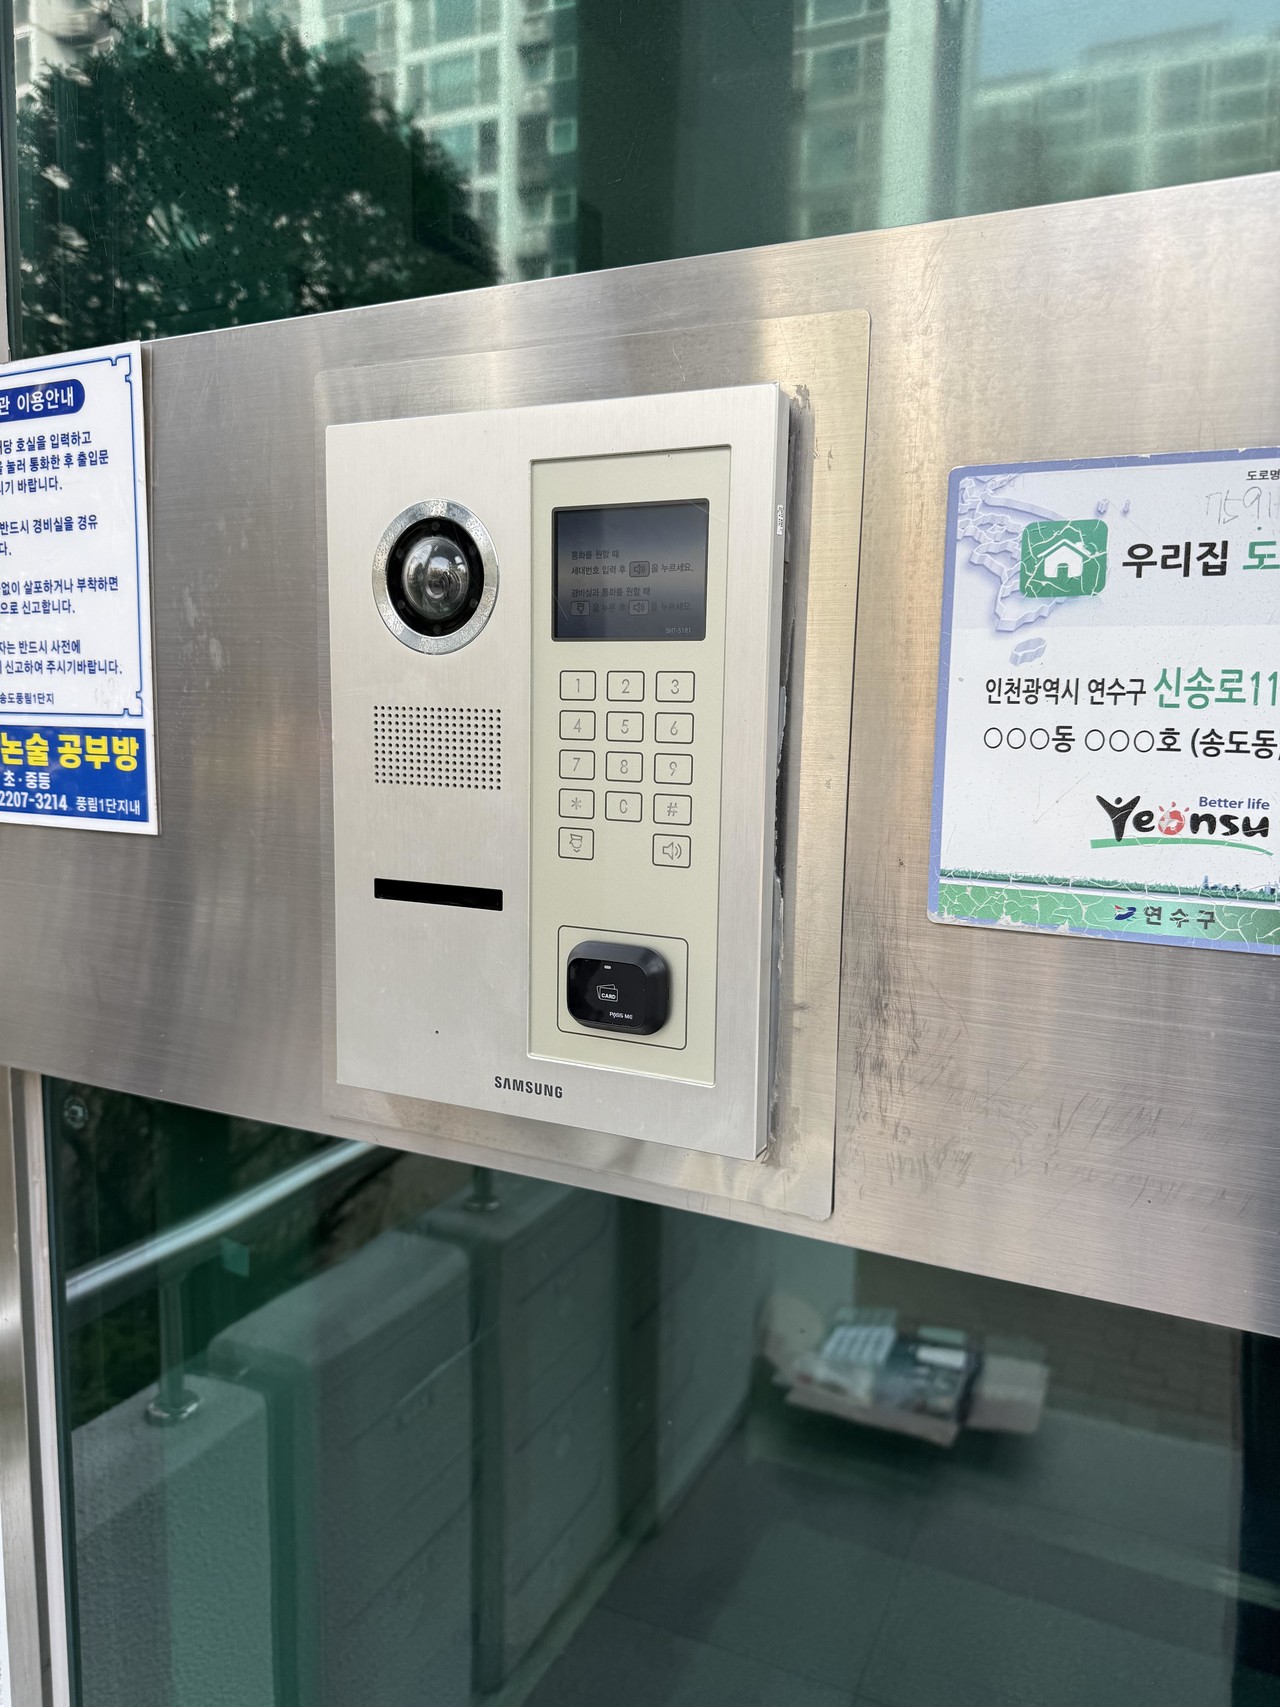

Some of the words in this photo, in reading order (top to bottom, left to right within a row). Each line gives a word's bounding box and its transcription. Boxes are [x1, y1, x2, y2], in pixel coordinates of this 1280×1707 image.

[17, 386, 74, 413] 이용안내
[0, 438, 12, 455] 당
[16, 435, 46, 451] 호실을
[50, 431, 92, 448] 입력하고
[7, 459, 26, 474] 눌러
[29, 455, 60, 472] 통화한
[64, 453, 73, 468] 후
[77, 449, 109, 466] 출입문
[17, 476, 62, 493] 바랍니다.
[1246, 469, 1280, 481] 도로명
[0, 520, 29, 536] 반드시
[33, 517, 74, 534] 경비실을
[78, 514, 98, 531] 경유
[1122, 540, 1228, 578] 우리집
[1242, 541, 1280, 570] 도
[571, 566, 599, 576] 세대번호
[602, 565, 616, 575] 입력
[618, 565, 627, 574] 후
[661, 562, 694, 573] 누르세요.
[0, 580, 20, 595] 없이
[23, 578, 74, 595] 살포하거나
[76, 576, 118, 592] 부착하면
[571, 588, 599, 598] 경비실과
[601, 587, 623, 597] 통화를
[0, 601, 19, 615] 으로
[22, 599, 75, 615] 신고합니다.
[19, 640, 48, 655] 반드시
[51, 639, 81, 655] 사전에
[5, 659, 44, 675] 신고하여
[46, 659, 123, 675] 주시기바랍니다.
[576, 678, 580, 693] 1
[621, 678, 630, 694] 2
[670, 679, 680, 694] 3
[985, 678, 1079, 706] 인천광역시
[1087, 678, 1147, 706] 연수구
[573, 718, 582, 733] 4
[620, 719, 630, 734] 5
[670, 720, 679, 736] 6
[0, 732, 49, 767] 논술
[57, 735, 140, 772] 공부방
[573, 757, 581, 772] 7
[620, 759, 629, 774] 8
[669, 761, 678, 776] 9
[75, 796, 141, 816] 풍림1단지내
[1199, 796, 1244, 810] Better
[1247, 798, 1270, 811] life
[1096, 795, 1270, 842] Yeonsu
[601, 992, 617, 1000] CARD
[494, 1075, 563, 1100] SAMSUNG
